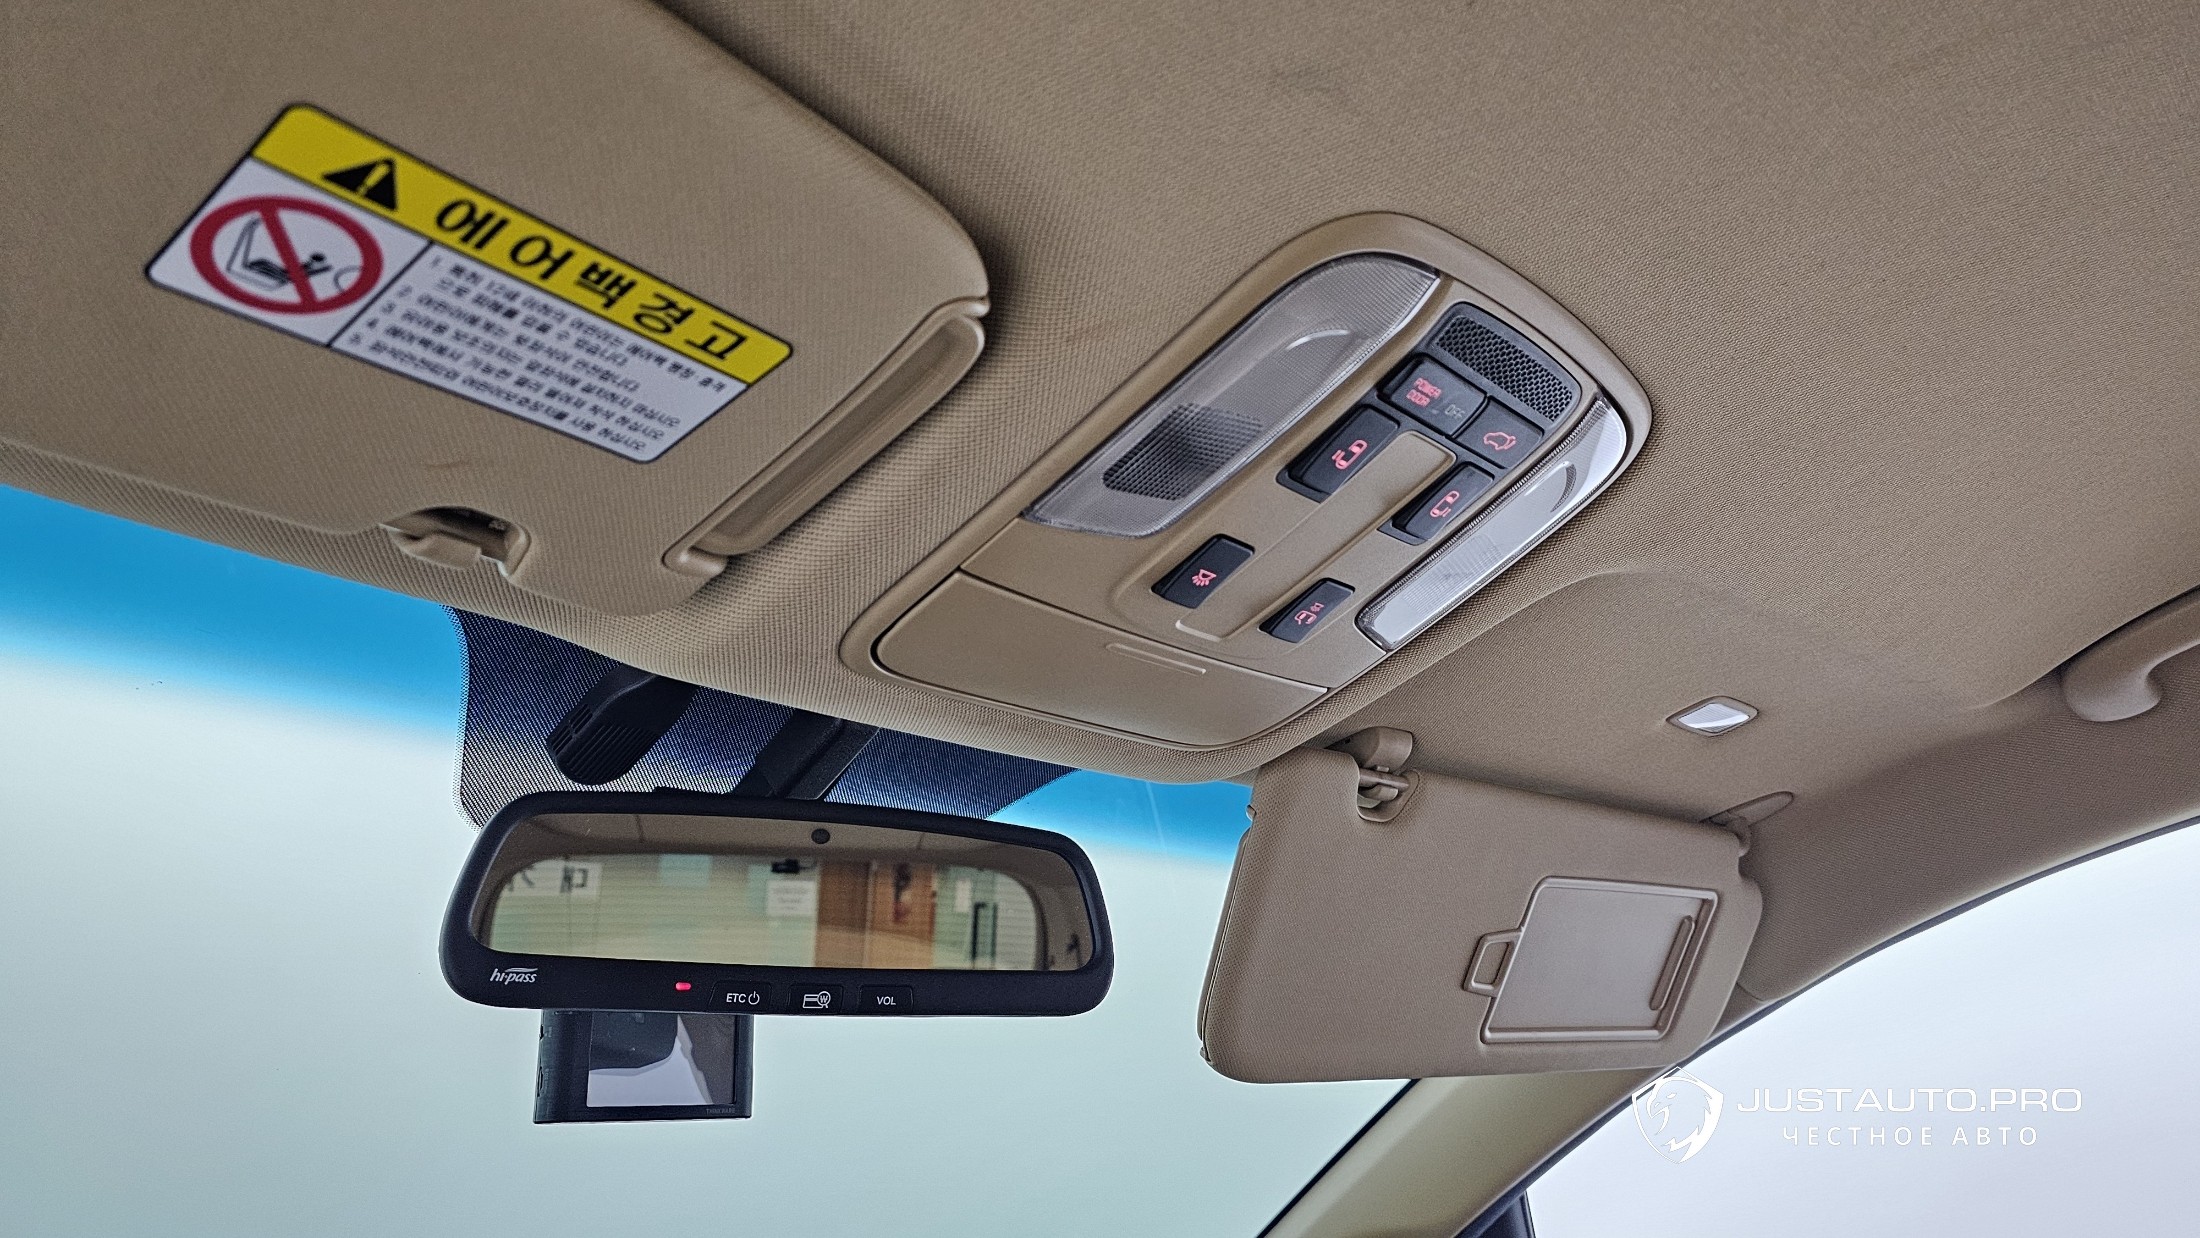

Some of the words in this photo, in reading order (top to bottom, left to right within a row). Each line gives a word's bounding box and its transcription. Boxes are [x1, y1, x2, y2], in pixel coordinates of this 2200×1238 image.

[625, 343, 669, 368] 에어백
[1414, 378, 1441, 399] POWER
[1406, 389, 1431, 407] DOOR
[726, 993, 747, 1004] ETC
[876, 996, 897, 1006] VOL
